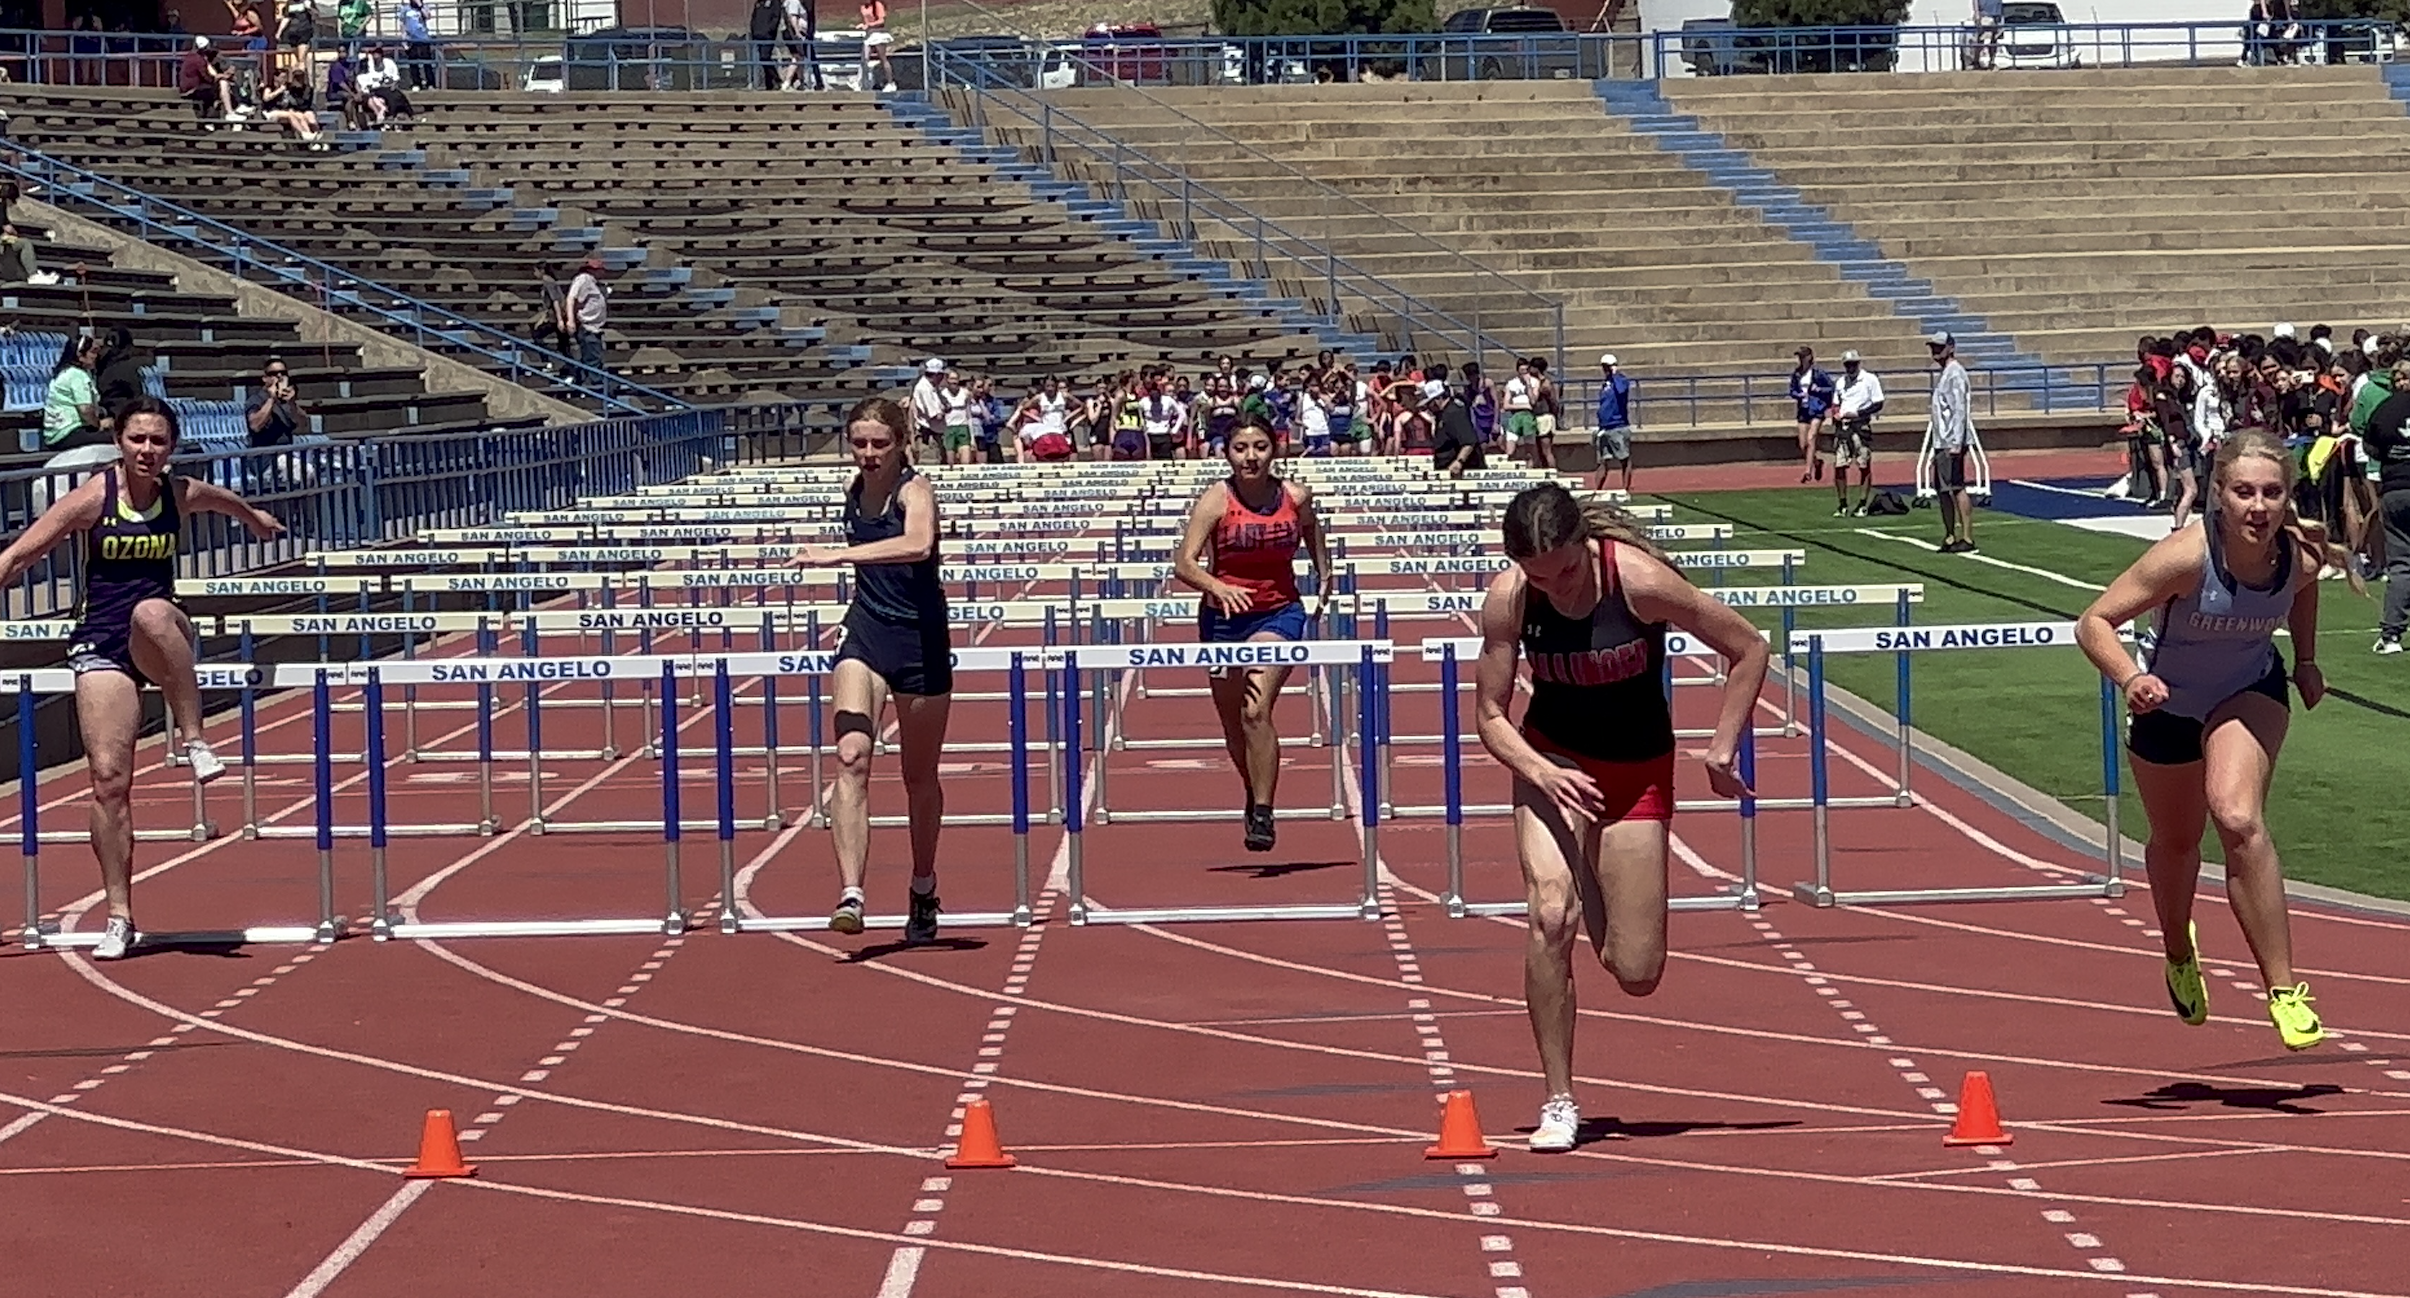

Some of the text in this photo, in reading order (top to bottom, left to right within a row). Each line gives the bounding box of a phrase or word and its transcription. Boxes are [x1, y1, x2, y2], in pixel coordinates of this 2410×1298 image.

[612, 499, 637, 507] SAN
[1023, 503, 1105, 513] SAN ANGELO
[1344, 498, 1370, 506] SAN
[543, 513, 625, 522] SAN ANGELO
[1356, 514, 1449, 525] SAN ANGELO
[640, 527, 731, 537] SAN ANGELO
[818, 526, 846, 535] SAN
[1000, 521, 1090, 530] SAN ANGELO
[461, 530, 552, 541] SAN ANGELO
[1375, 533, 1479, 545] SAN ANGELO
[102, 534, 176, 560] OZONA
[758, 548, 791, 558] SAN
[964, 541, 1068, 553] SAN ANGELO
[355, 552, 459, 565] SAN ANGELO
[558, 549, 662, 560] SAN ANGELO
[1152, 566, 1175, 578] SA
[1390, 559, 1511, 573] SAN ANGELO
[683, 571, 804, 586] SAN ANGELO
[962, 567, 1038, 580] ANGELO
[205, 580, 326, 594] SAN ANGELO
[448, 576, 568, 590] SAN ANGELO
[1427, 596, 1473, 610] SAN
[1714, 589, 1857, 605] SAN ANGELO
[1145, 602, 1189, 616] SAN
[292, 616, 437, 632] SAN ANGELO
[579, 610, 723, 628] SAN ANGELO
[5, 624, 50, 638] SAN
[1875, 627, 2054, 649] SAN ANGELO
[1129, 645, 1309, 665] SAN ANGELO
[779, 654, 833, 673] SAN
[432, 660, 611, 681] SAN ANGELO
